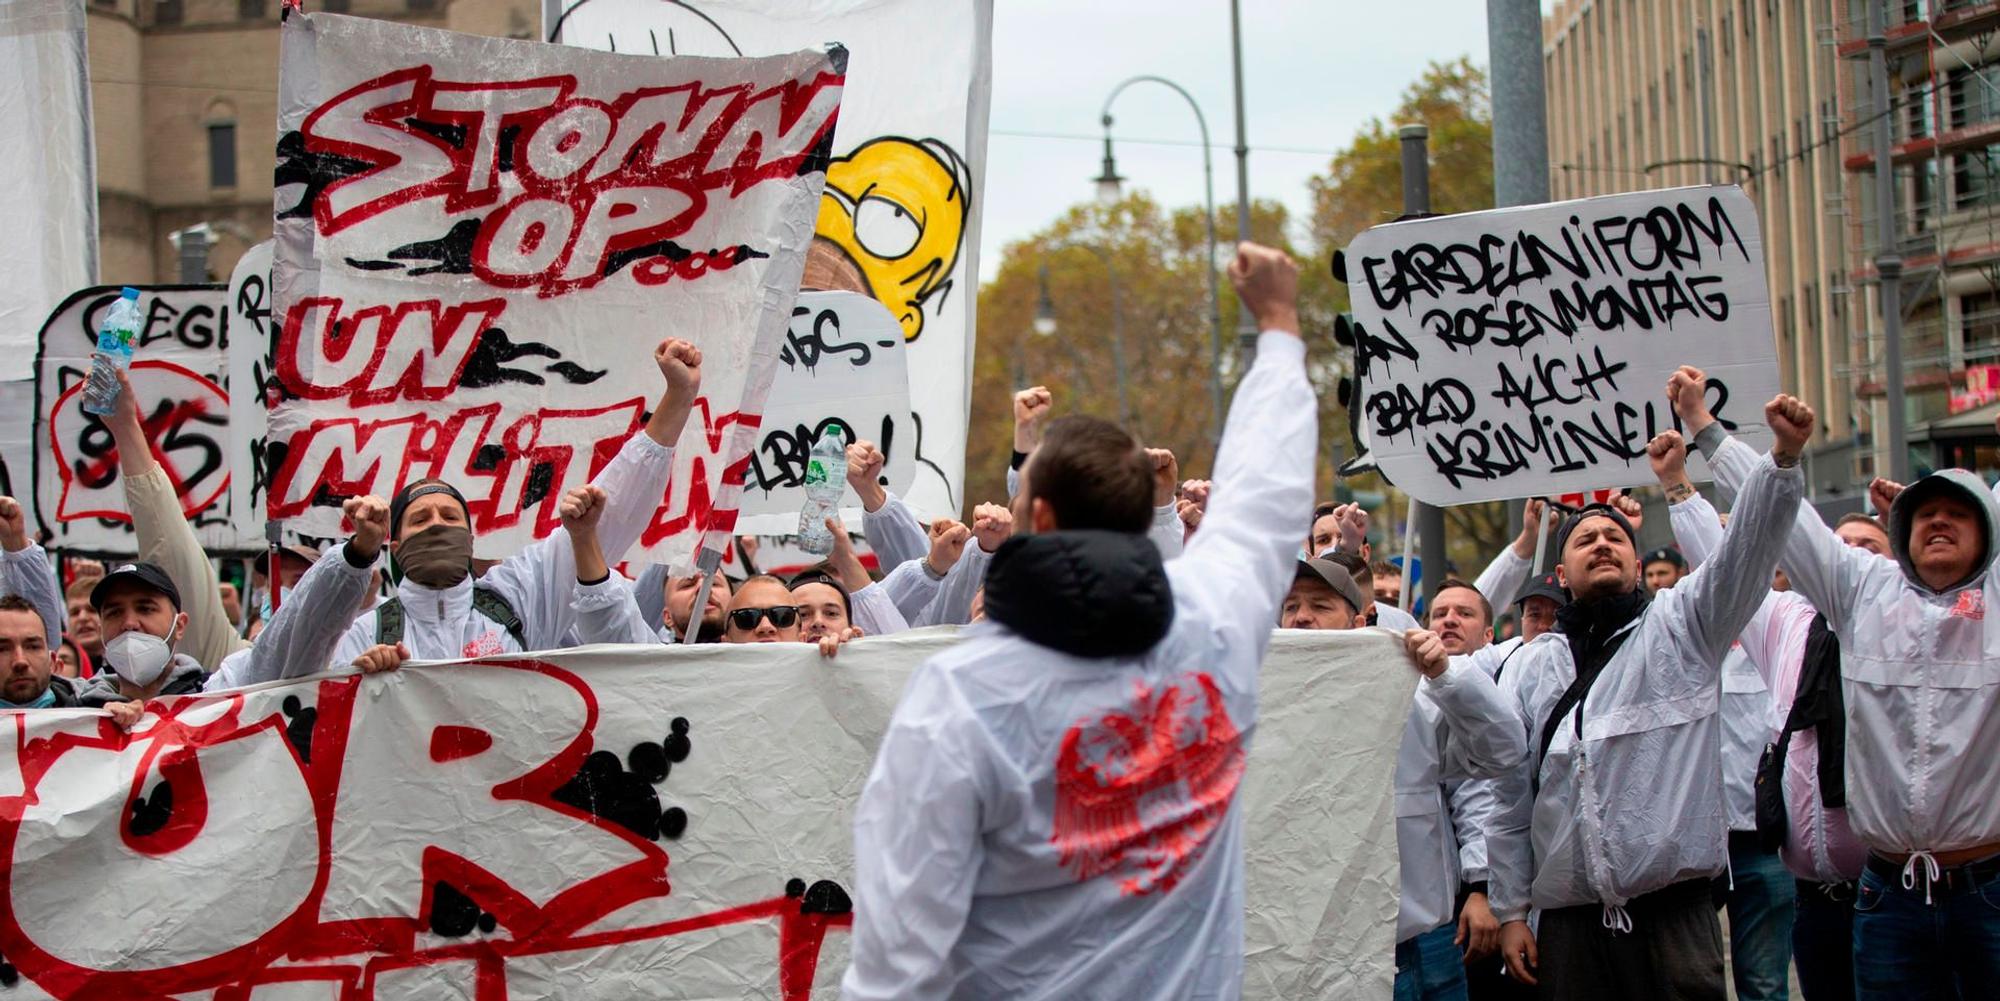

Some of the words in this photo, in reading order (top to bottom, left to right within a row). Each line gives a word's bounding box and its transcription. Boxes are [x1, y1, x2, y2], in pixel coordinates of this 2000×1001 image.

[302, 63, 846, 237] STONN
[274, 296, 507, 408] UN
[1354, 318, 1419, 376] AN
[1421, 271, 1729, 352] ROSENMONTAG
[1366, 378, 1475, 438] BALD
[1492, 345, 1627, 411] AUCH
